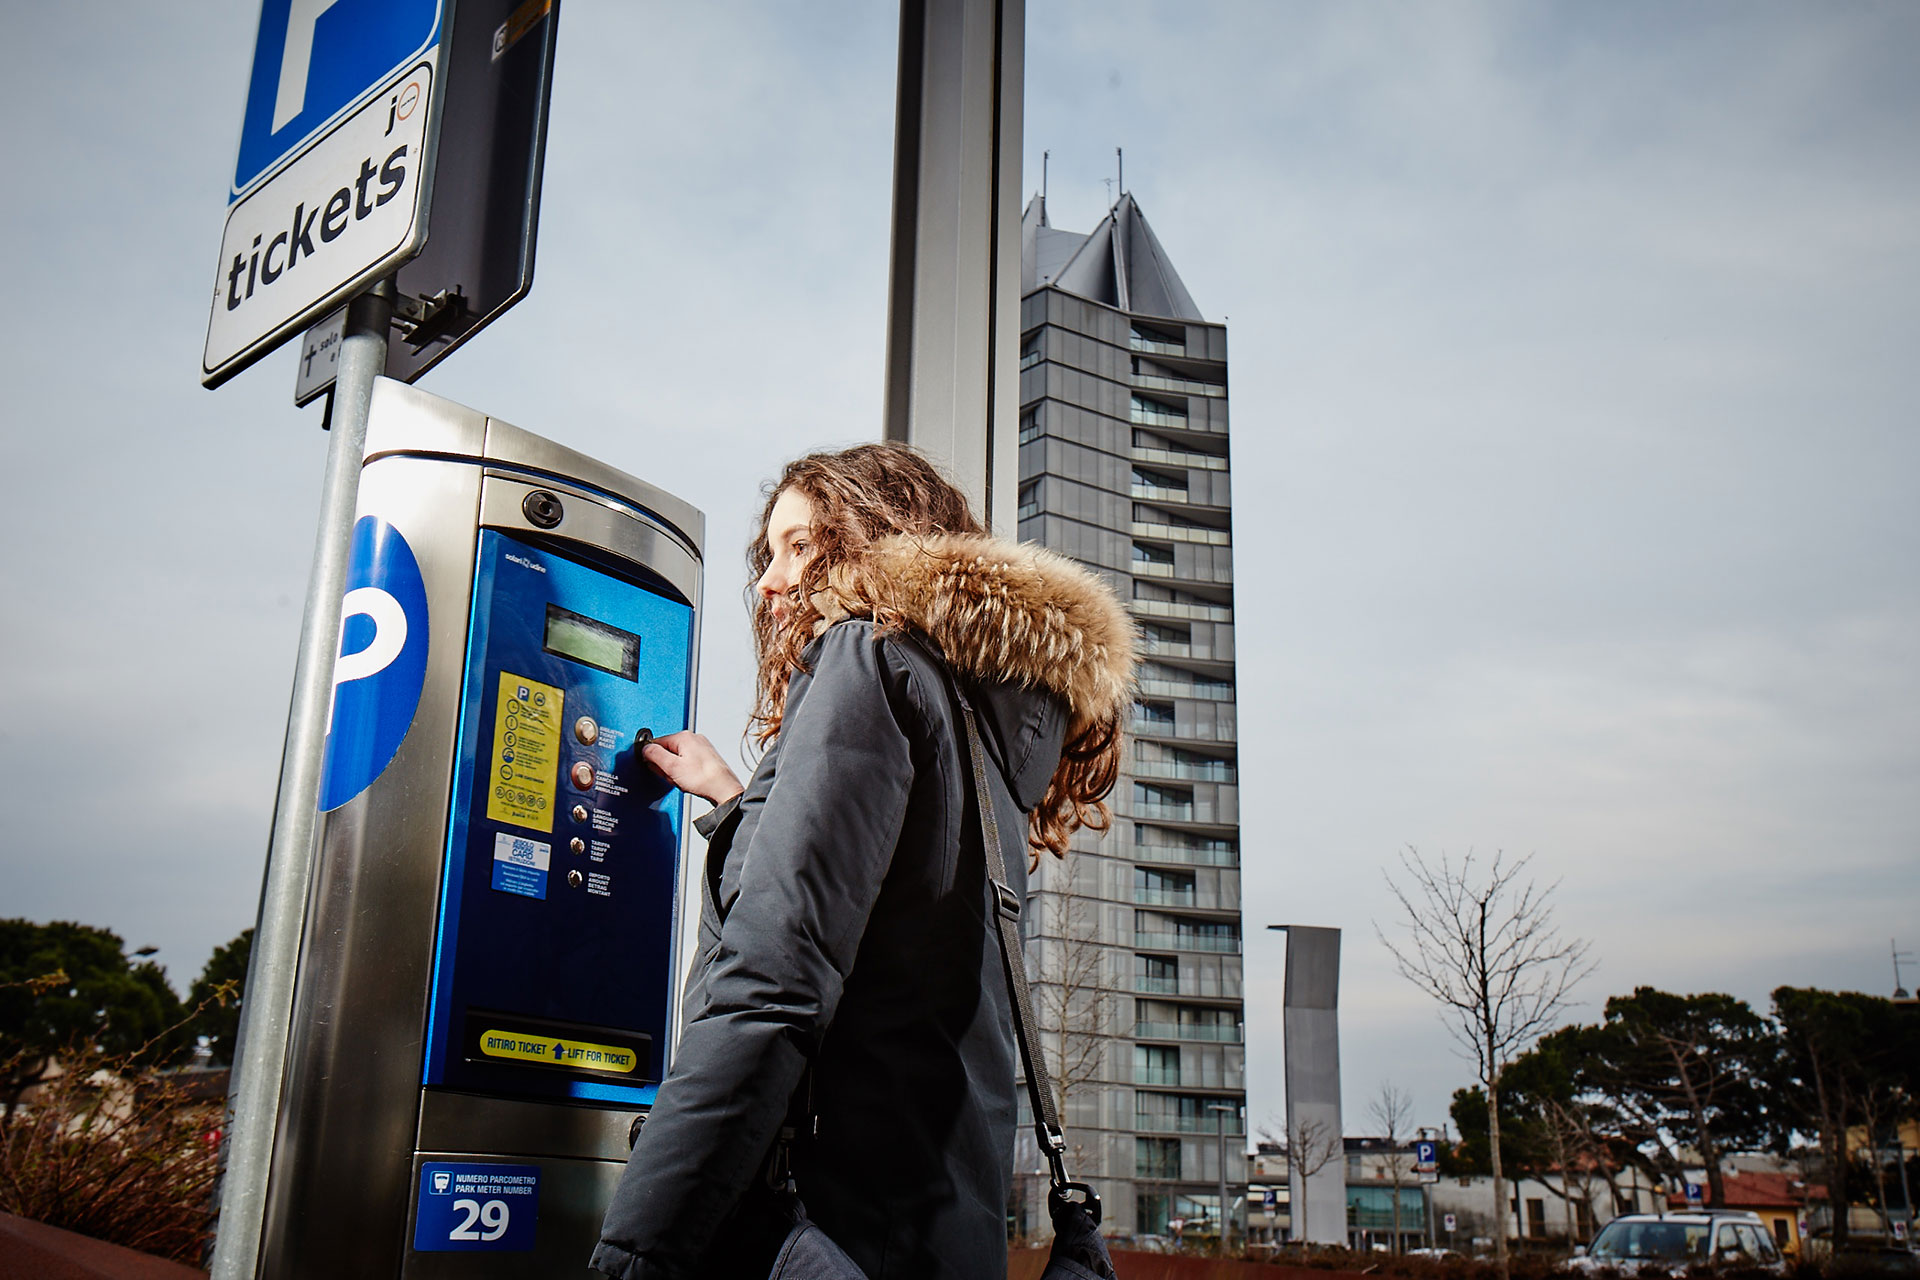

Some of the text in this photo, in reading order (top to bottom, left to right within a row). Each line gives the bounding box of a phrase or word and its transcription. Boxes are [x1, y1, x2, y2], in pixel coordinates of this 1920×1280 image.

[227, 144, 407, 312] tickets
[519, 687, 528, 699] P
[592, 813, 619, 824] LANGUAGE
[591, 839, 611, 849] TARIFFA
[487, 1037, 548, 1055] RITIRO TICKET
[567, 1047, 631, 1066] LIFT FOR TICKET
[1420, 1145, 1431, 1160] P
[455, 1174, 537, 1185] NUMERO PARCOMETRO
[454, 1185, 533, 1195] PARK METER NUMBER
[449, 1198, 510, 1241] 29
